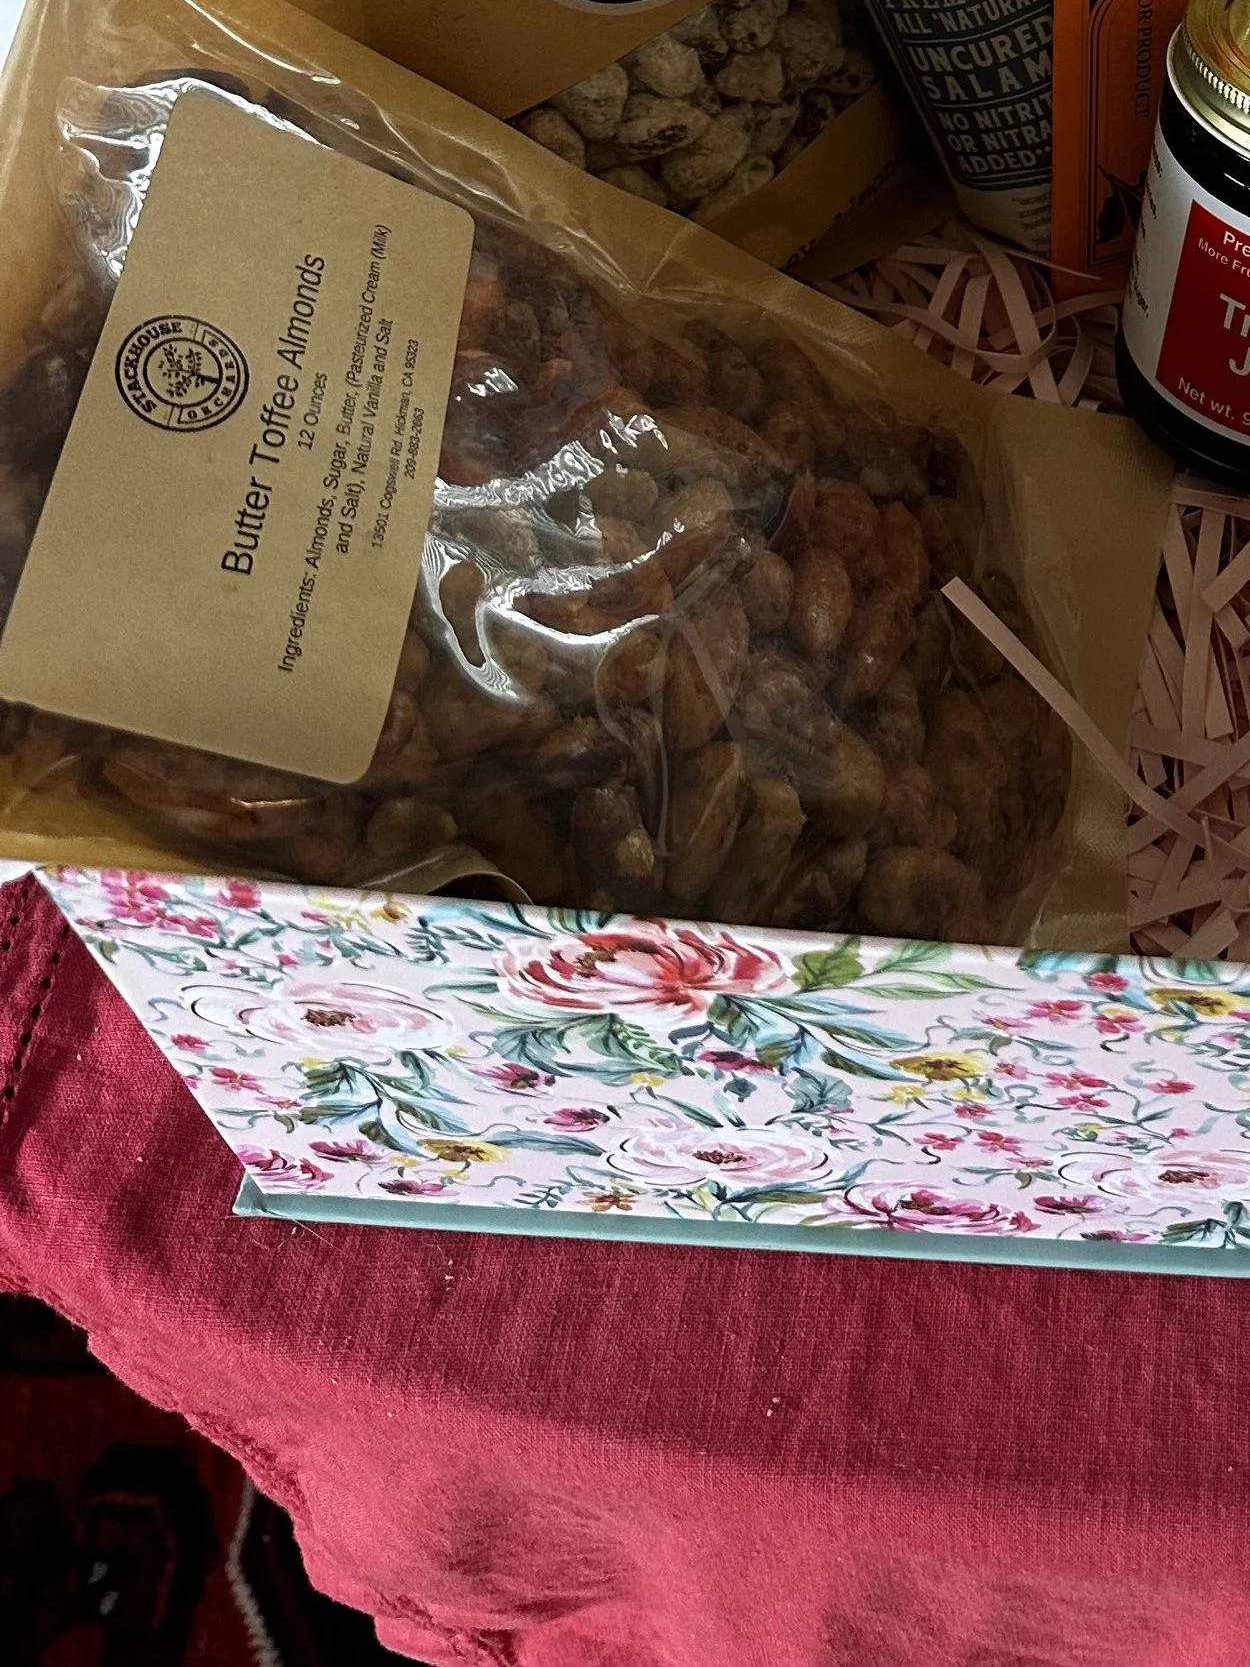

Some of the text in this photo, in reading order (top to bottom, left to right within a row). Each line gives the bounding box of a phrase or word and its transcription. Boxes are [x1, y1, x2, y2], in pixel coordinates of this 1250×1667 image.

[893, 10, 932, 35] ALL
[907, 15, 1053, 73] UNCURED
[1133, 25, 1152, 118] PRODUCT
[937, 108, 969, 133] NO
[948, 132, 980, 154] OR
[1196, 237, 1230, 266] More
[123, 321, 183, 414] STACKHOUSE
[405, 338, 420, 371] 95323
[402, 371, 415, 388] CA
[1176, 376, 1206, 405] Net
[1209, 398, 1236, 422] wt.
[221, 253, 325, 575] Butter Toffee Almonds
[298, 371, 328, 451] 12 Ounces
[277, 224, 393, 673] Ingredients: Almonds, Sugar, Butter, (Pasteurized Cream (Milk)
[336, 317, 394, 555] and Salt), Natural Vanilla and Salt
[372, 512, 390, 550] 13501
